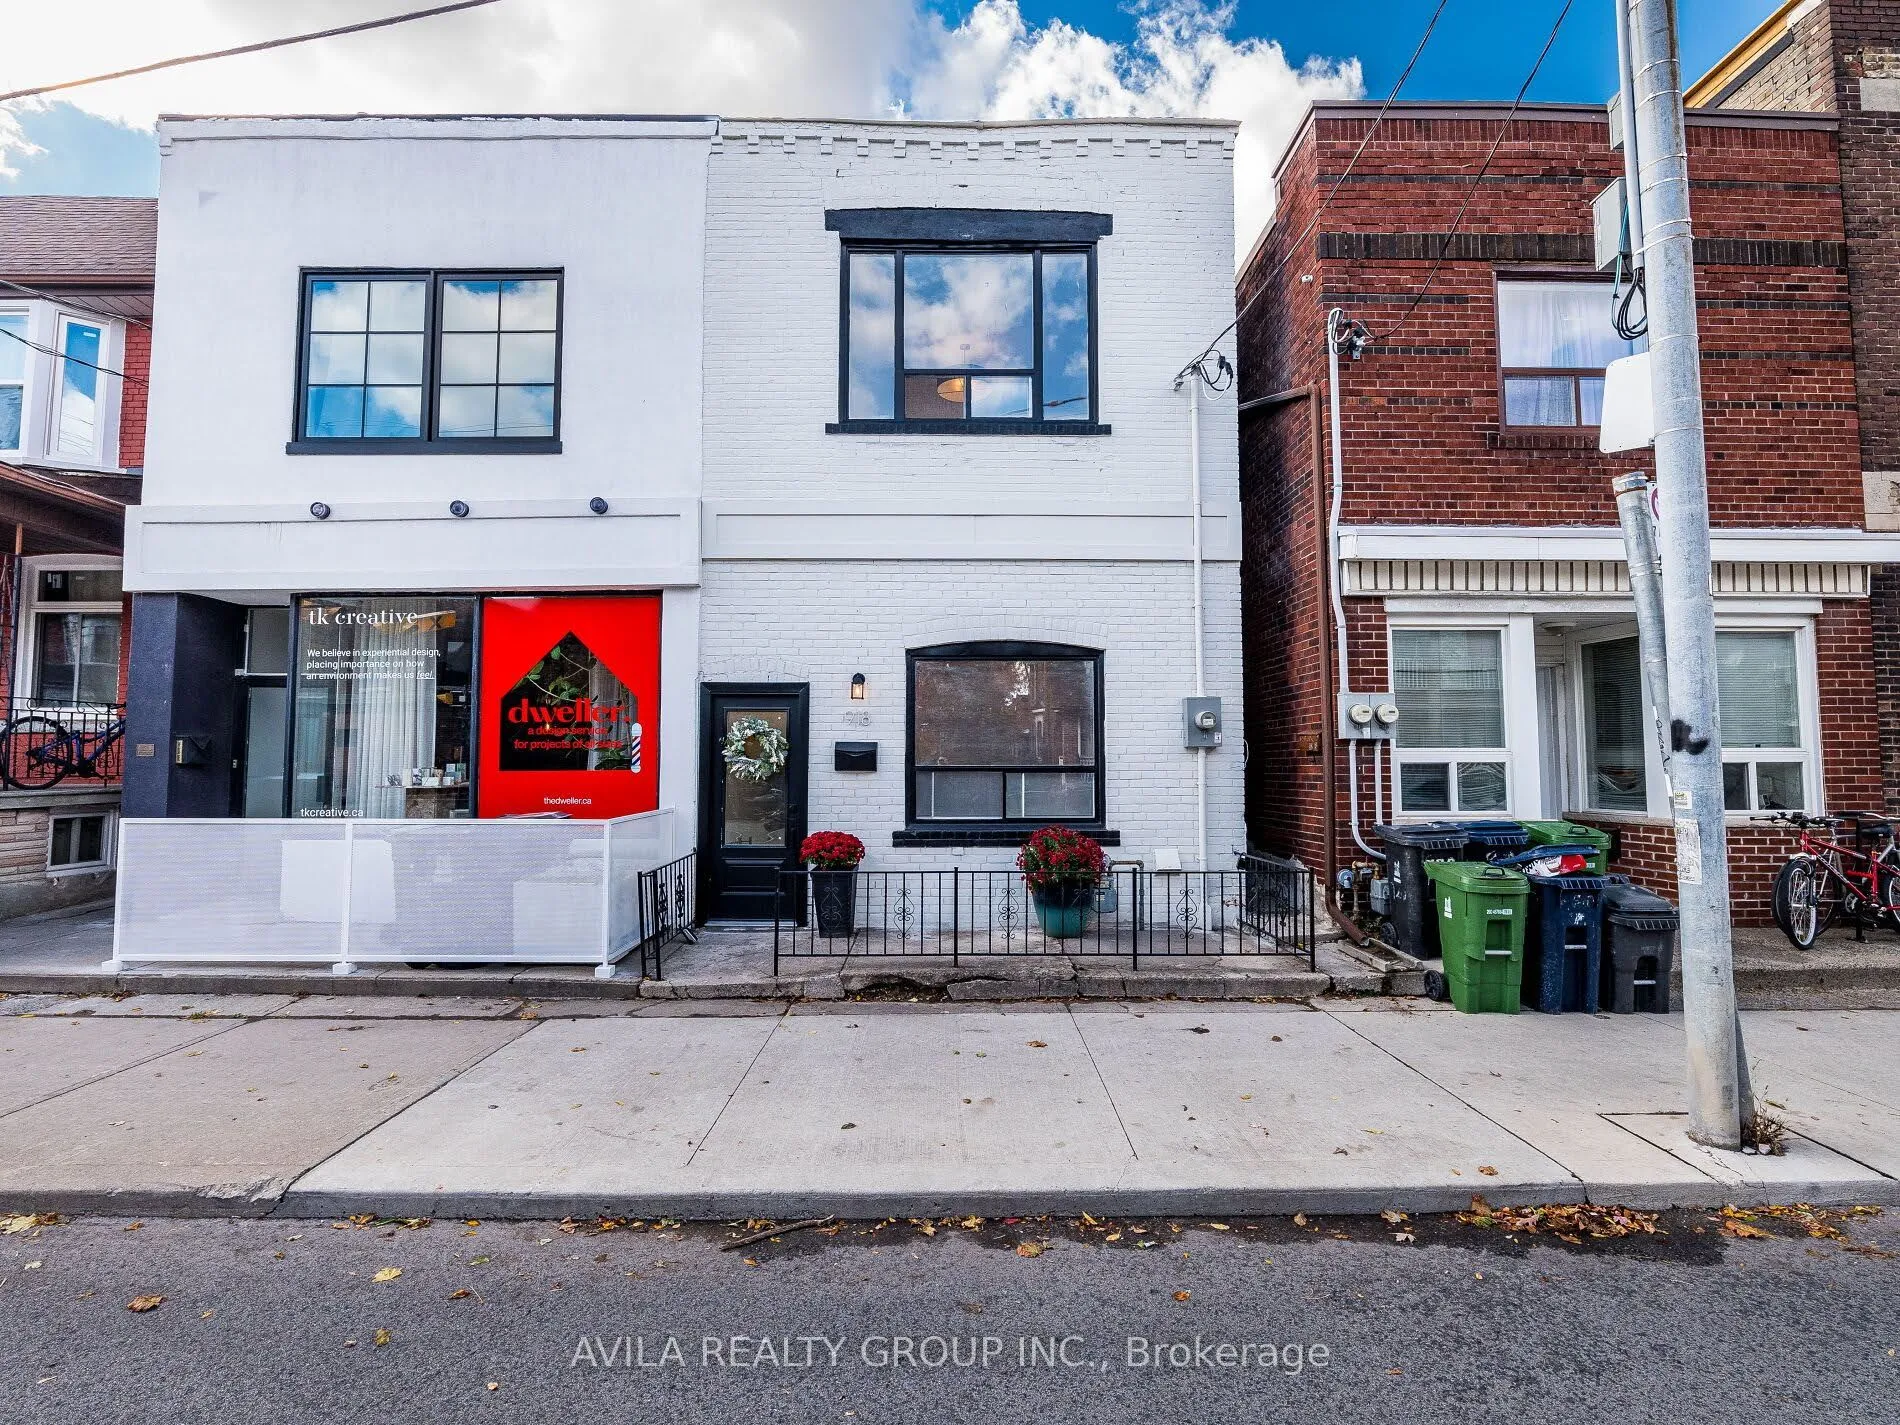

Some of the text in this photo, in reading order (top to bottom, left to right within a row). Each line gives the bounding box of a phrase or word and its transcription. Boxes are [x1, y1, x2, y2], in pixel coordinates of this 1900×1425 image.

[309, 607, 418, 625] tk creative
[306, 647, 441, 658] We believe in experiential design,
[306, 660, 338, 670] placing
[340, 660, 390, 669] importance
[405, 659, 425, 668] how
[318, 671, 372, 680] environment
[373, 670, 401, 678] makes
[527, 727, 535, 735] a
[536, 726, 569, 737] design
[514, 740, 528, 749] for
[530, 740, 571, 750] projects
[572, 740, 585, 749] of
[543, 796, 592, 805] thedweller.ca
[300, 807, 364, 817] tkcreative.ca
